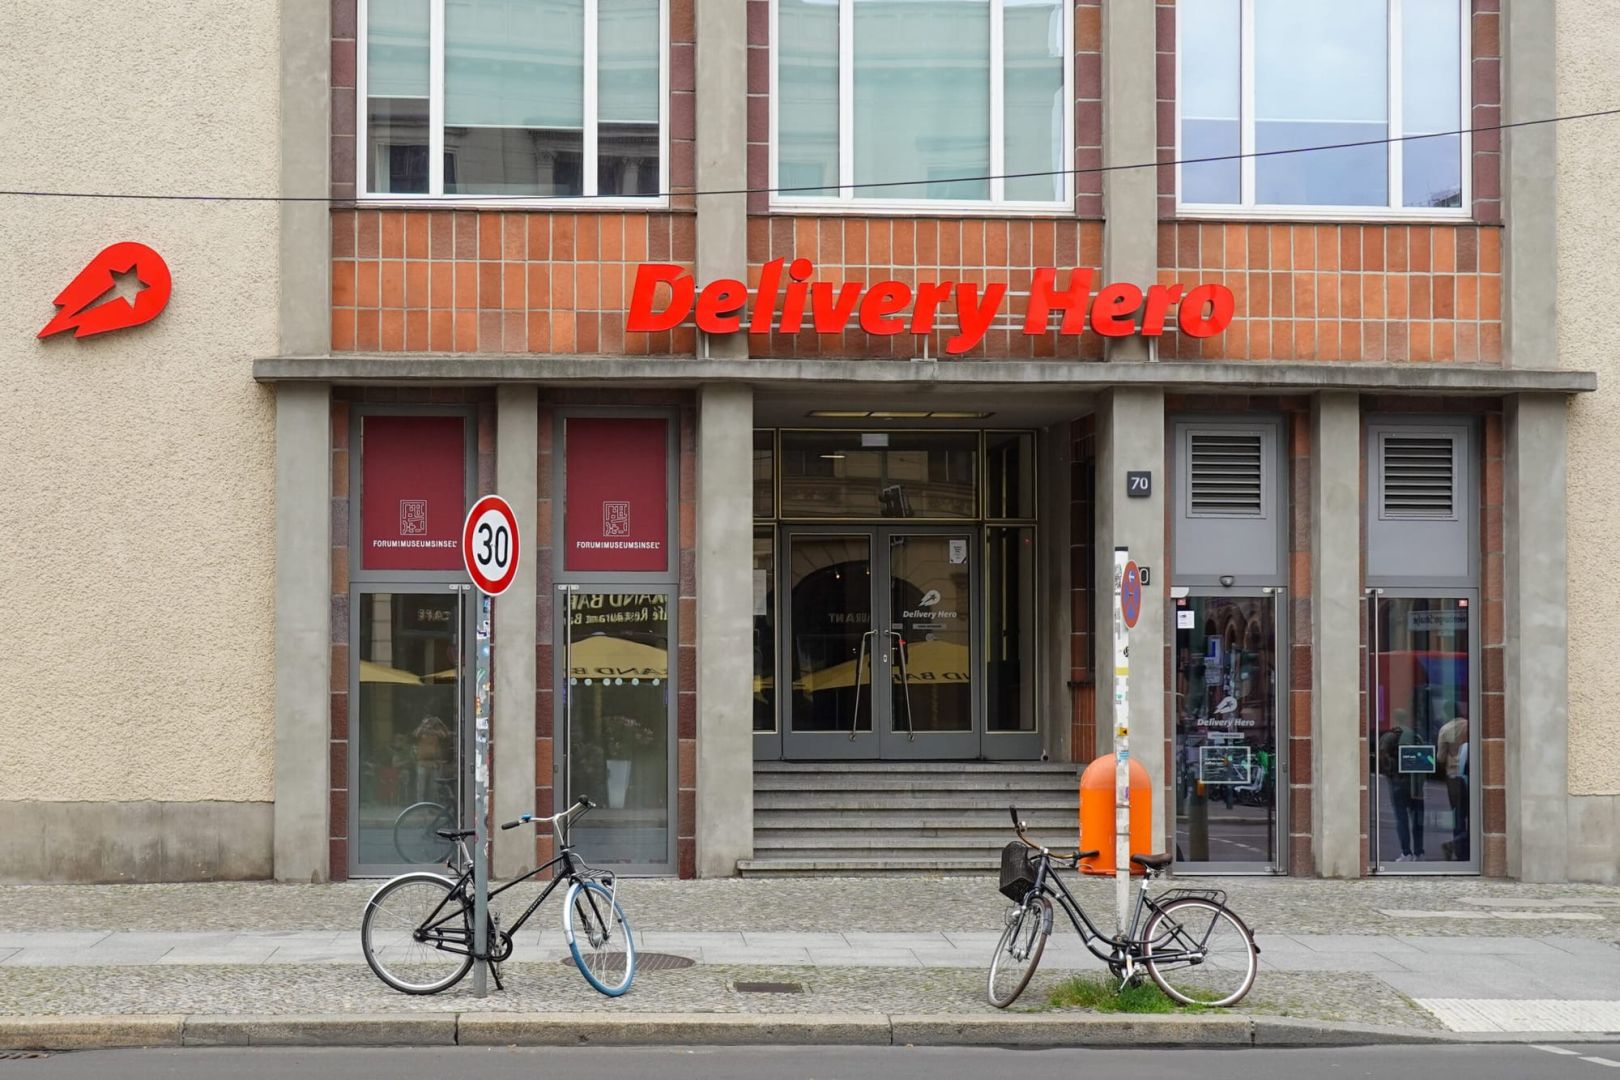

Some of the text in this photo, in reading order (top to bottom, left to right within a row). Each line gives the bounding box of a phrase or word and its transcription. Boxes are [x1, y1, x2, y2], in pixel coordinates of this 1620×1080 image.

[626, 257, 1235, 354] Delivery Hero
[1131, 476, 1149, 491] 70
[477, 522, 508, 568] 30
[1138, 567, 1149, 584] 0
[903, 610, 957, 620] Delivery Hero
[1197, 718, 1255, 729] Delivery Hero
